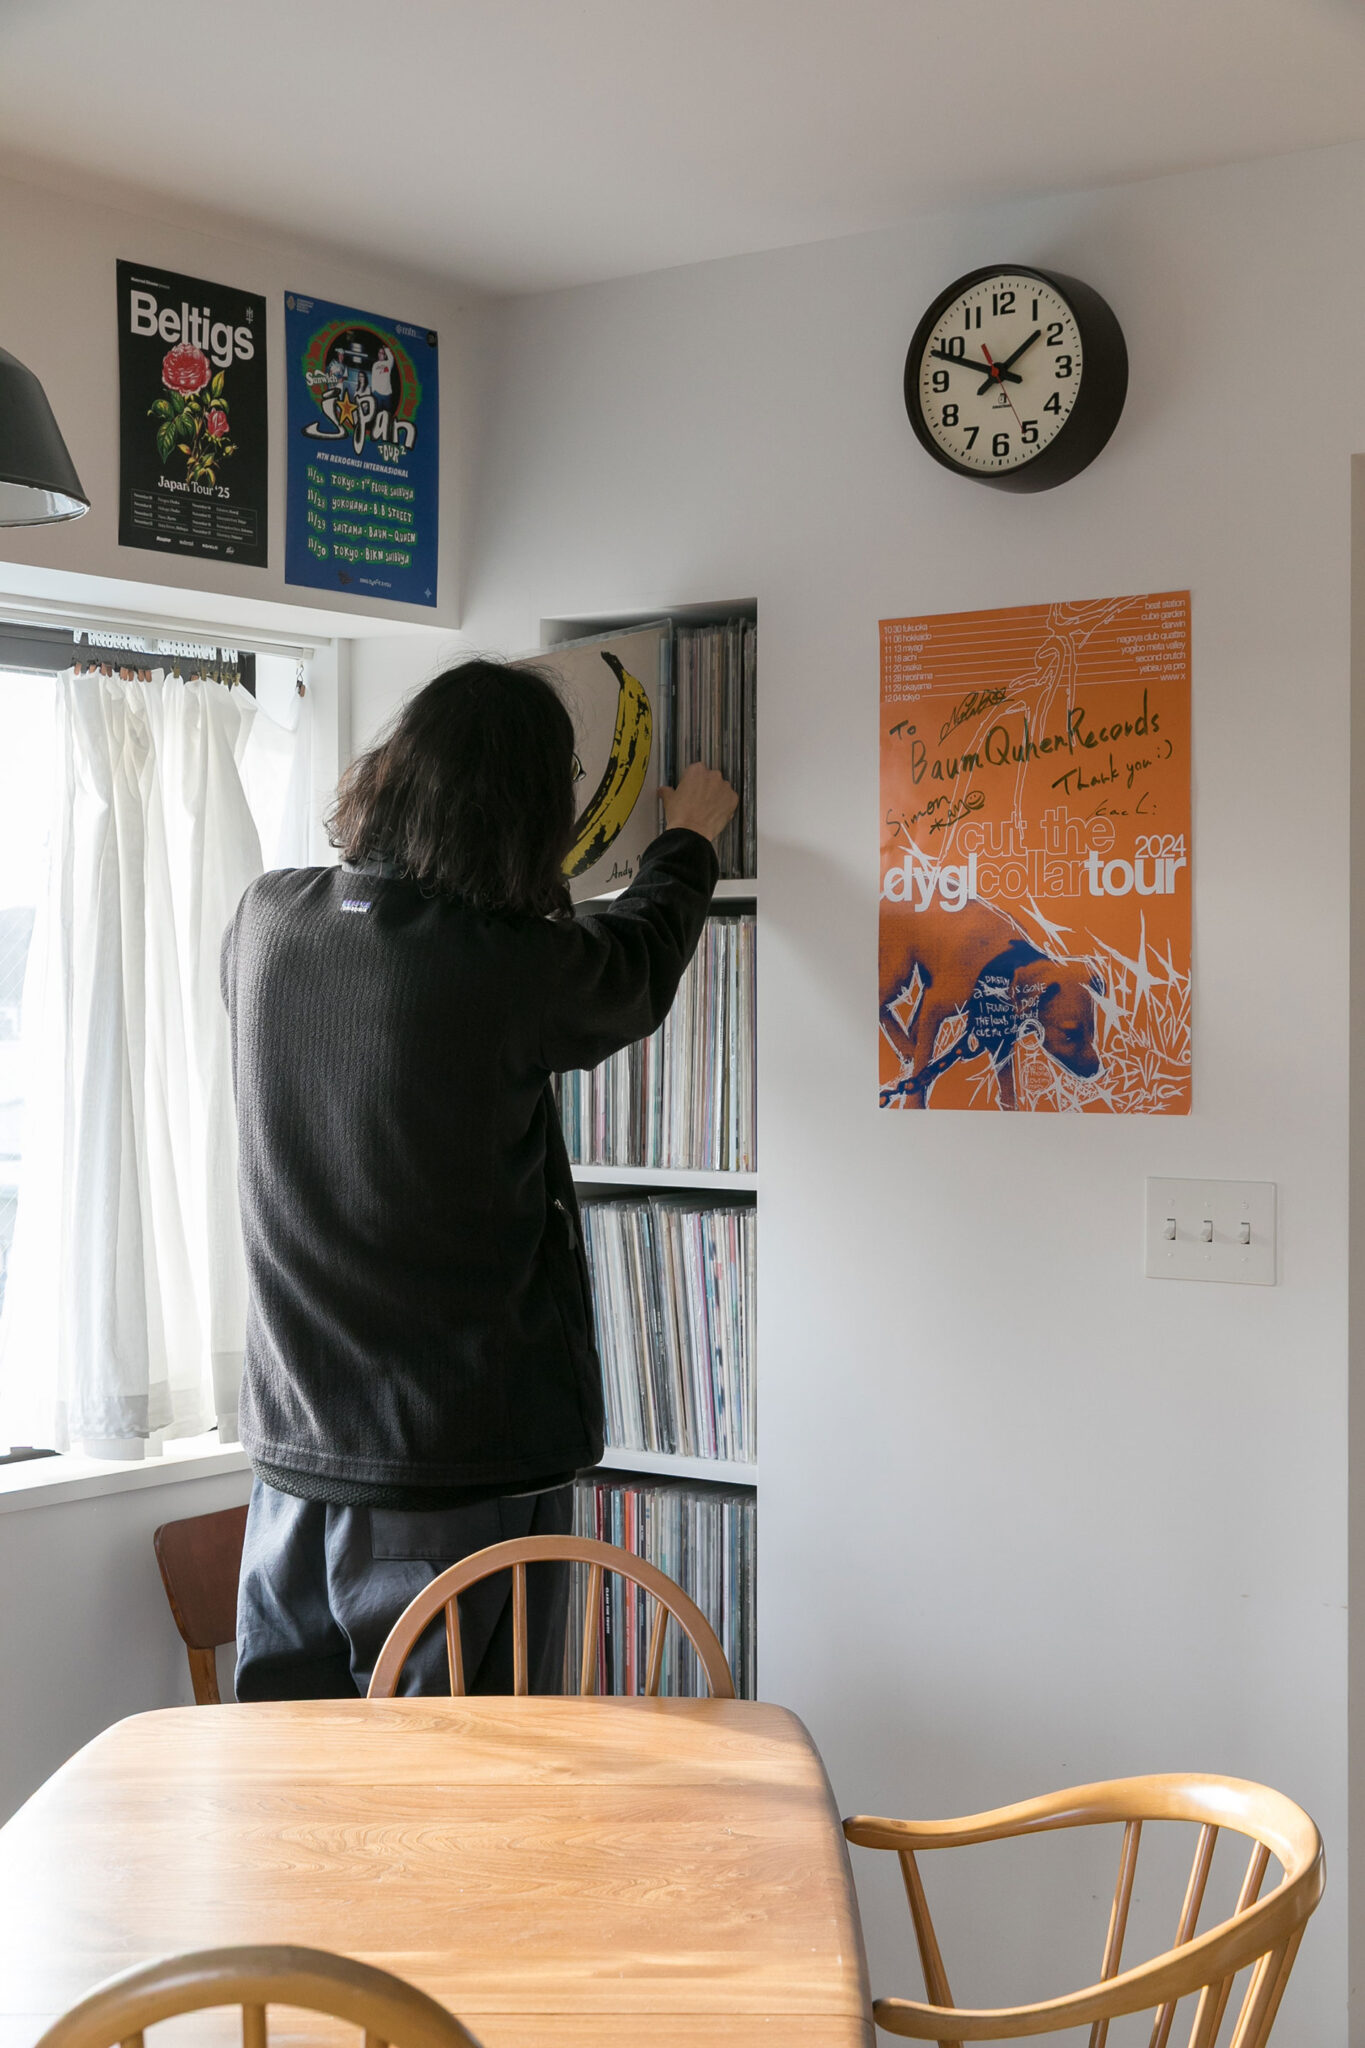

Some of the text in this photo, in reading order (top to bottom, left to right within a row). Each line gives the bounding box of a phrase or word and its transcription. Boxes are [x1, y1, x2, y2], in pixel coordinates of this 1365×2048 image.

[992, 291, 1016, 316] 12
[1032, 299, 1038, 321] 1
[131, 289, 254, 368] Beltigs
[965, 306, 982, 330] 11
[1047, 322, 1064, 346] 2
[940, 336, 965, 360] 10
[305, 369, 338, 386] Sunwich
[1055, 355, 1072, 379] 3
[932, 370, 950, 393] 9
[1043, 392, 1062, 415] 4
[304, 388, 416, 455] Jpan
[942, 404, 959, 427] 8
[963, 426, 980, 450] 7
[1021, 420, 1039, 444] 5
[378, 445, 399, 463] TOUR
[992, 433, 1010, 457] 6
[364, 461, 408, 478] INTERNASIONAL
[158, 475, 190, 492] Japan
[190, 480, 214, 496] Tour
[331, 474, 354, 490] TOKYO
[332, 498, 368, 513] YOKOHAMA
[388, 508, 412, 522] STREET
[308, 512, 326, 530] 11/29
[333, 522, 362, 535] SAITAMA
[308, 538, 326, 557] 11/30
[333, 544, 358, 561] TOKYO
[1160, 610, 1186, 620] garden
[1116, 634, 1143, 644] nagoya
[1144, 632, 1160, 640] club
[1136, 653, 1162, 662] second
[1162, 652, 1186, 660] crutch
[902, 682, 932, 692] okayama
[902, 693, 920, 702] tokyo
[889, 720, 917, 740] To
[911, 740, 983, 785] Baum
[1067, 688, 1161, 755] Records
[1052, 752, 1119, 795] Thank
[1126, 759, 1152, 789] you
[957, 811, 1027, 858] cut
[1040, 806, 1116, 854] the
[1134, 834, 1187, 860] 2024
[606, 859, 632, 883] Andy
[883, 849, 1187, 912] dygl collar tour
[1022, 982, 1046, 994] GONE
